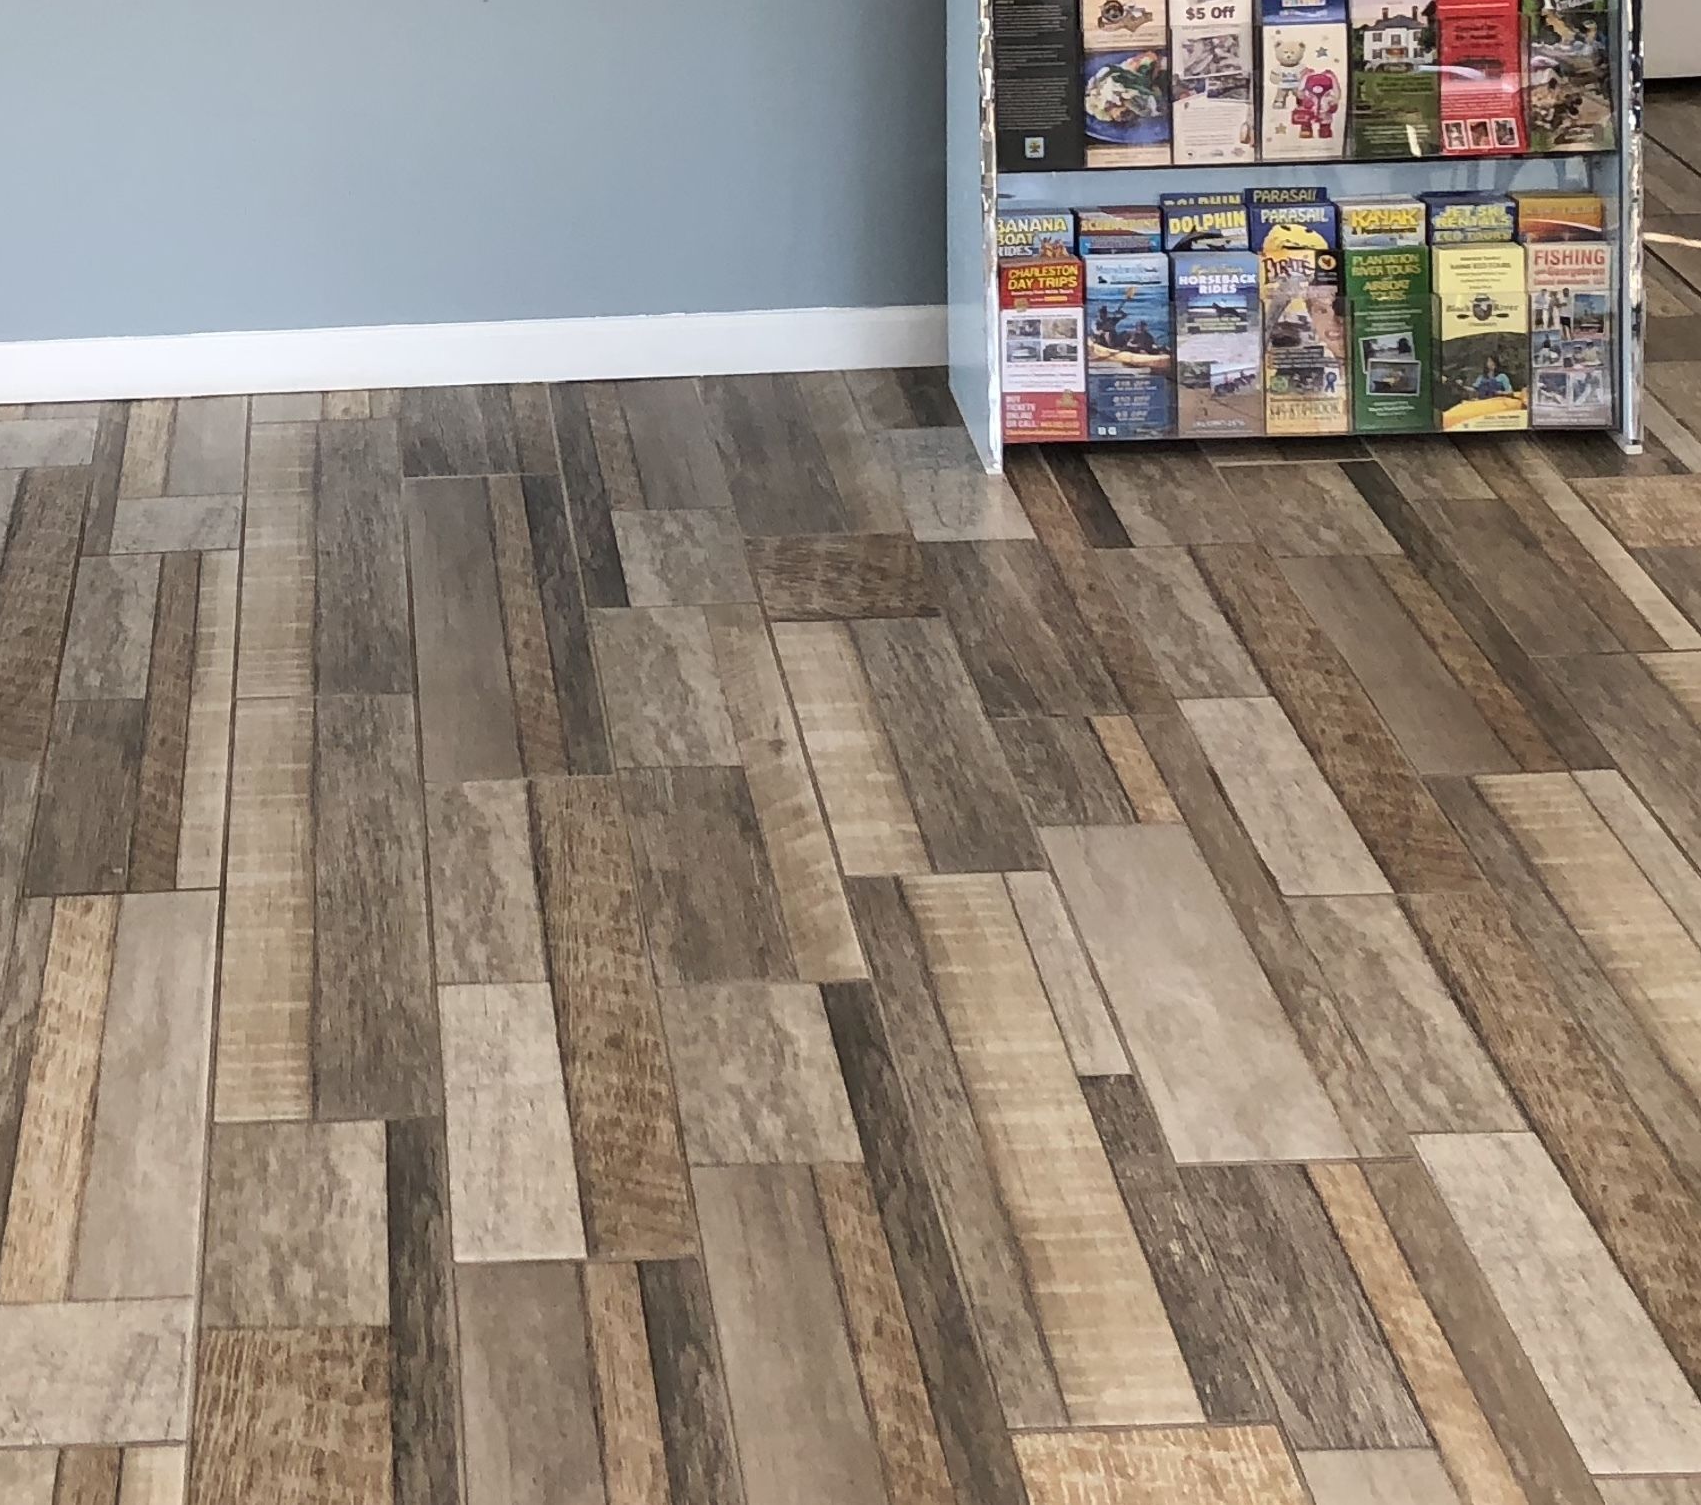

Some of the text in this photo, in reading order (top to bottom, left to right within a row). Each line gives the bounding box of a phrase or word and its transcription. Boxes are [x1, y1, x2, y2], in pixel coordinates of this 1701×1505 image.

[1185, 5, 1236, 22] $5 Off
[1168, 210, 1246, 234] DOLPHIN
[1260, 207, 1329, 223] PARASAIL
[1351, 209, 1419, 228] KAYAK
[1352, 253, 1420, 267] PLANTATION
[1533, 249, 1606, 266] FISHING
[1008, 265, 1079, 279] CHARLESTON
[1262, 256, 1315, 284] PIRATE
[1352, 264, 1421, 277] RIVER TOURS
[1007, 276, 1079, 291] DAY TRIPS
[1178, 273, 1257, 286] HORSEBACK
[1198, 283, 1237, 294] RIDES
